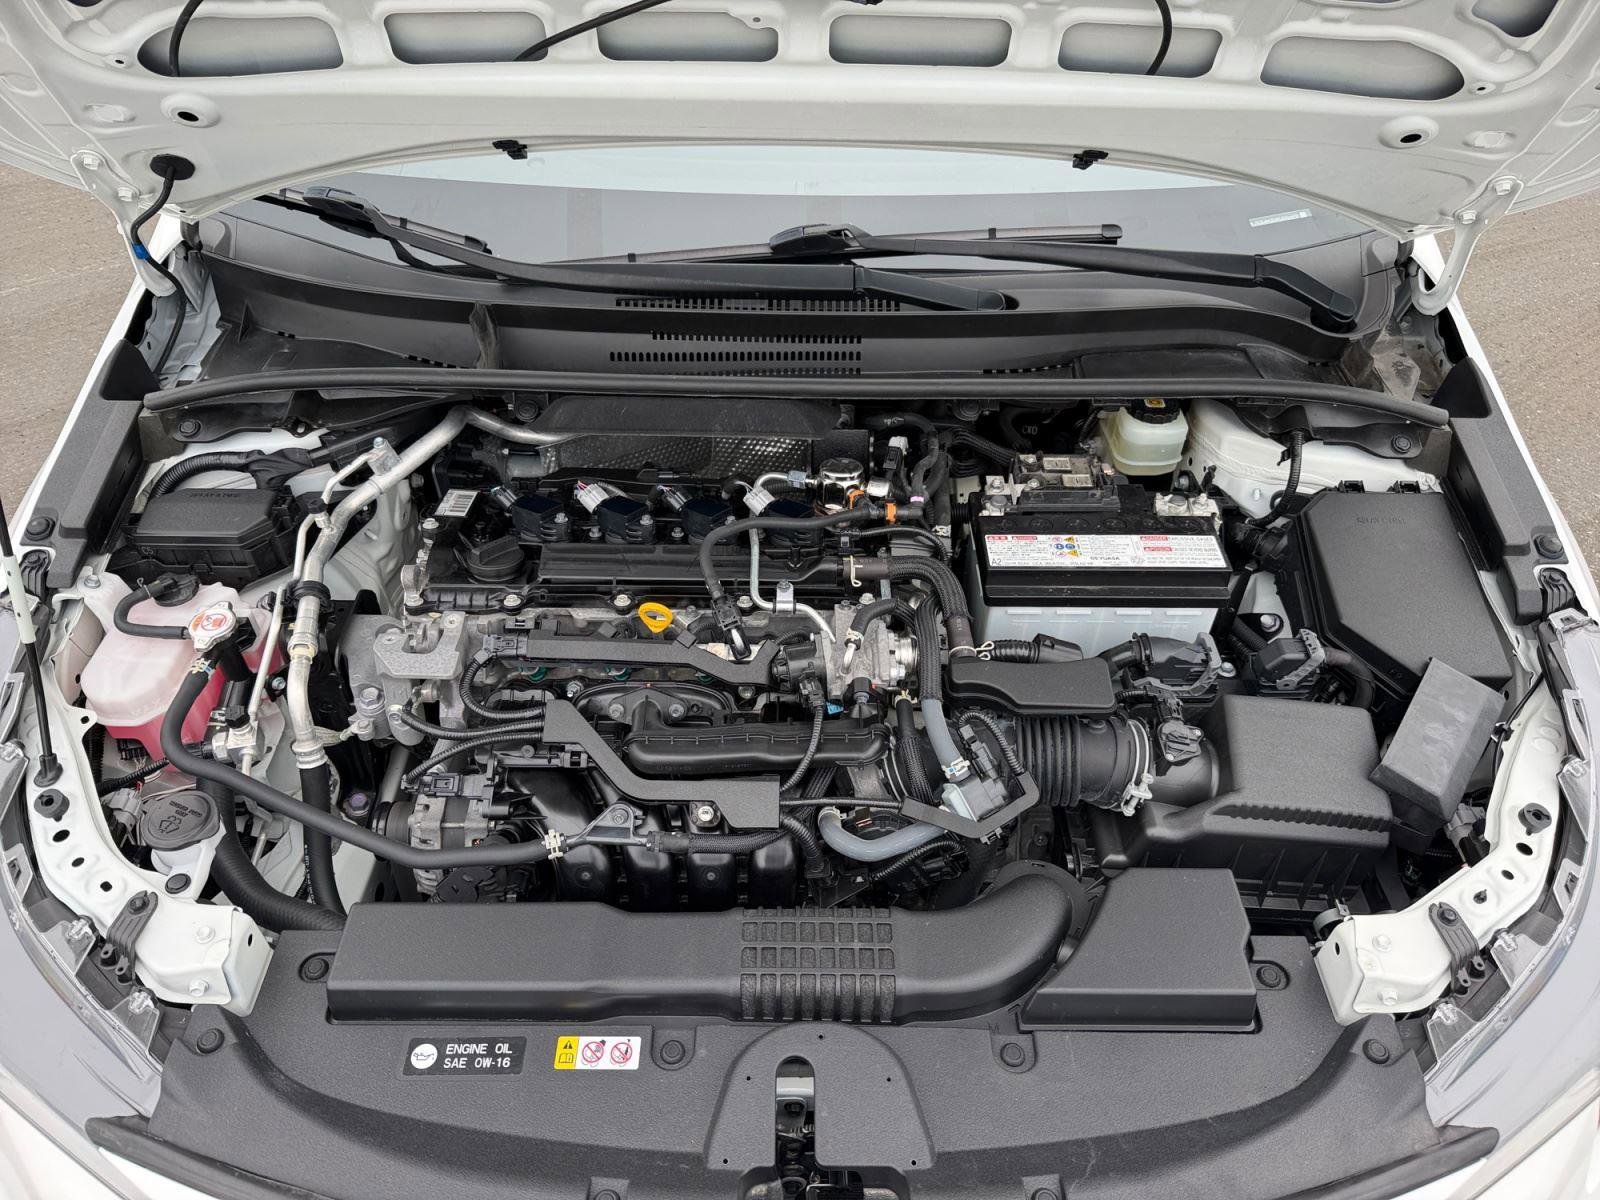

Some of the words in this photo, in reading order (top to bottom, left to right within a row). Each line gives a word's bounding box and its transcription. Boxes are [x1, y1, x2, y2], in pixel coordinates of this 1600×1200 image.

[991, 558, 1002, 566] A2
[446, 1043, 488, 1055] ENGINE
[494, 1043, 513, 1054] OIL
[443, 1057, 468, 1069] SAE
